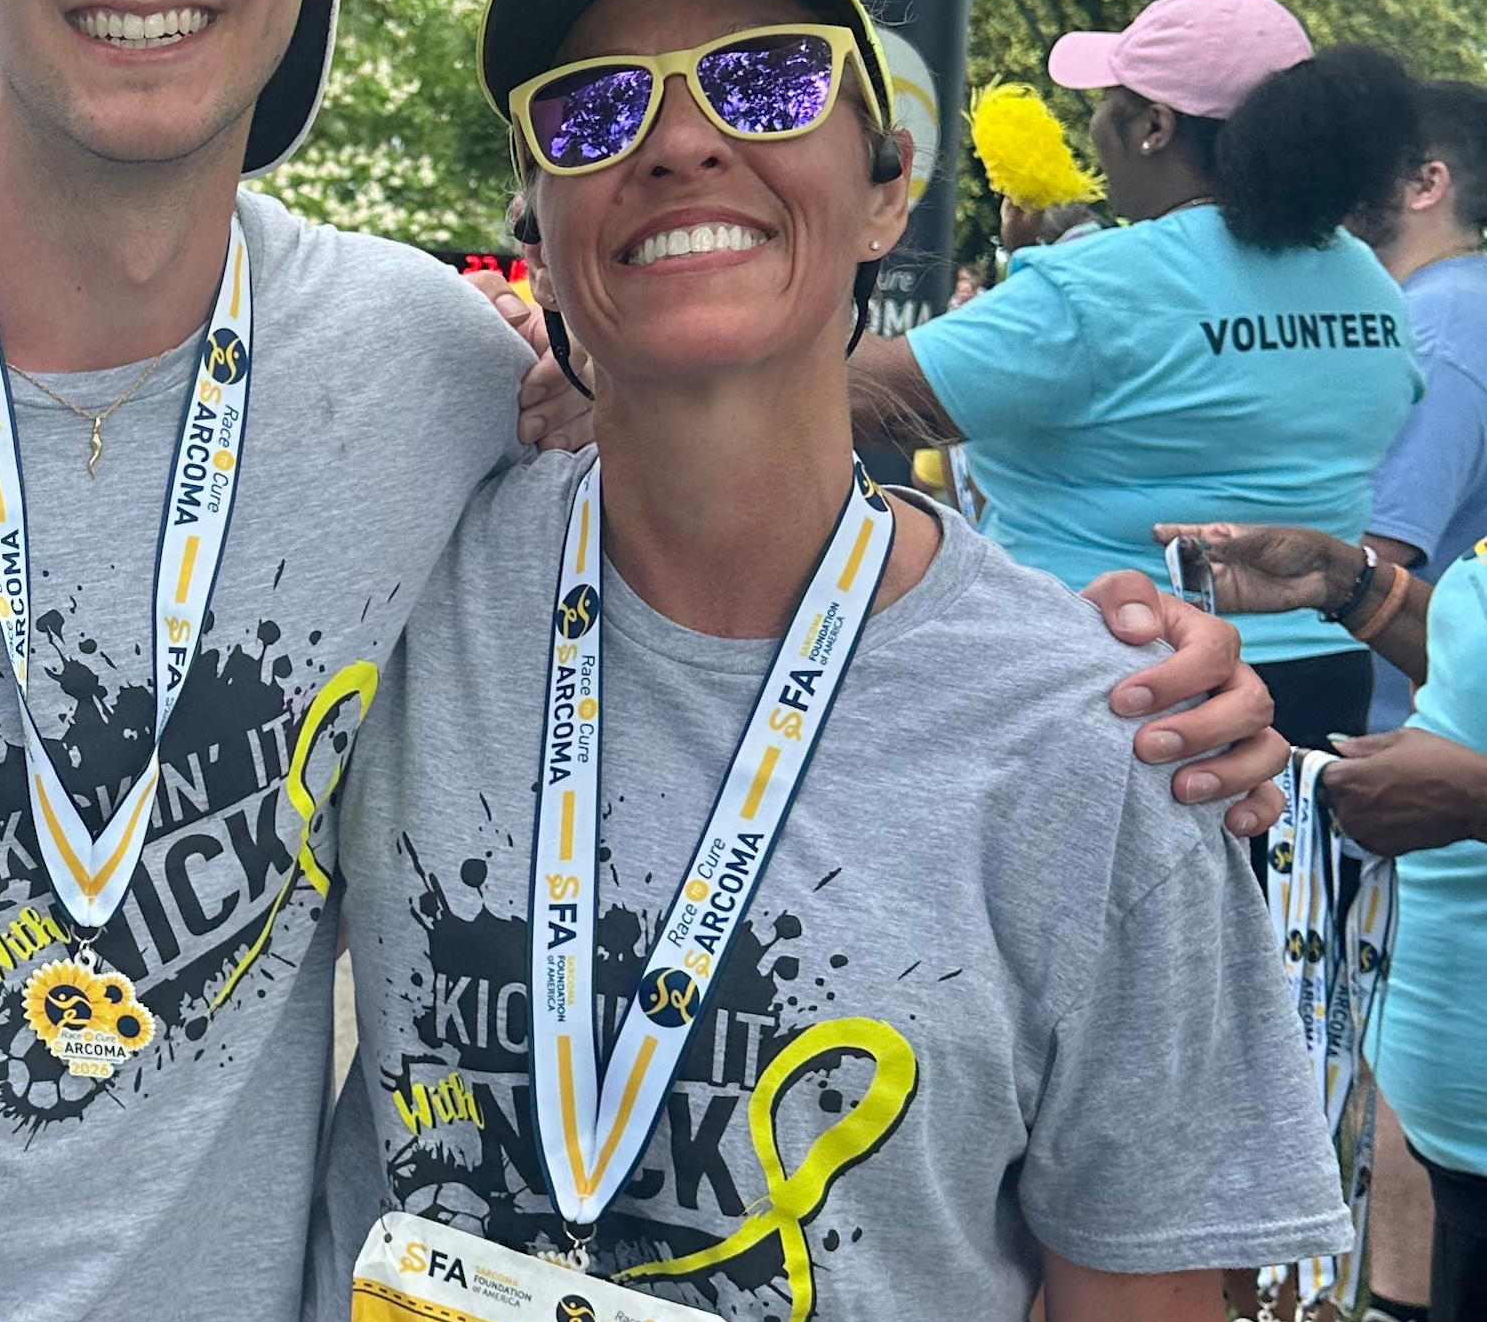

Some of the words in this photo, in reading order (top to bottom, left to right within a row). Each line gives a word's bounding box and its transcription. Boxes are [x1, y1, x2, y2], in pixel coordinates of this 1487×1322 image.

[1200, 313, 1401, 356] VOLUNTEER
[174, 380, 222, 526] SARCOMA
[219, 404, 239, 448] Race
[208, 472, 229, 513] Cure
[164, 616, 191, 692] SFA
[808, 601, 840, 662] FOUNDATION
[581, 655, 595, 695] Race
[769, 670, 824, 742] SFA
[549, 643, 577, 785] SARCOMA
[578, 723, 594, 763] Cure
[546, 874, 580, 950] SFA
[667, 903, 698, 947] Race
[697, 838, 726, 879] Cure
[684, 834, 764, 979] SARCOMA
[557, 955, 566, 1022] FOUNDATION
[72, 1062, 109, 1076] 2026
[712, 1008, 776, 1089] IT
[393, 1072, 485, 1135] With
[399, 1242, 468, 1290] SFA
[473, 1275, 532, 1302] FOUNDATION
[482, 1289, 521, 1307] AMERICA
